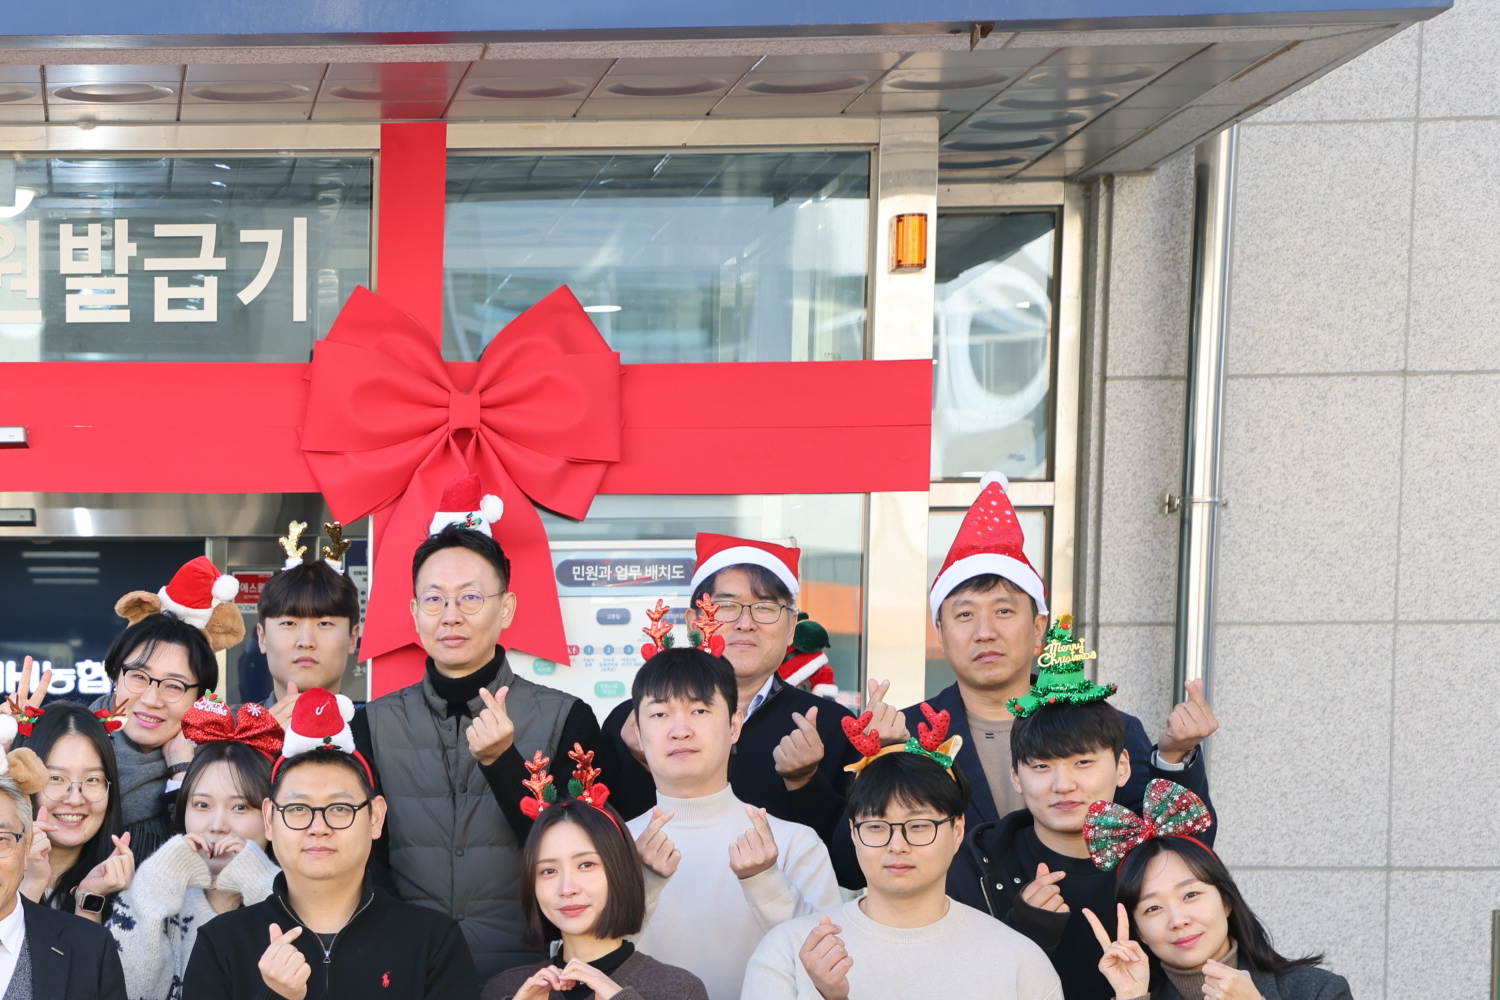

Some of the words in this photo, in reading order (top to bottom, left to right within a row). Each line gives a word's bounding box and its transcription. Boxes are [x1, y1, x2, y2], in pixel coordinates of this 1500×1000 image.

[572, 565, 612, 581] 민원과
[615, 565, 642, 580] 업무
[645, 564, 685, 581] 배치도
[1044, 638, 1086, 654] Merry
[1037, 650, 1097, 668] Christmas
